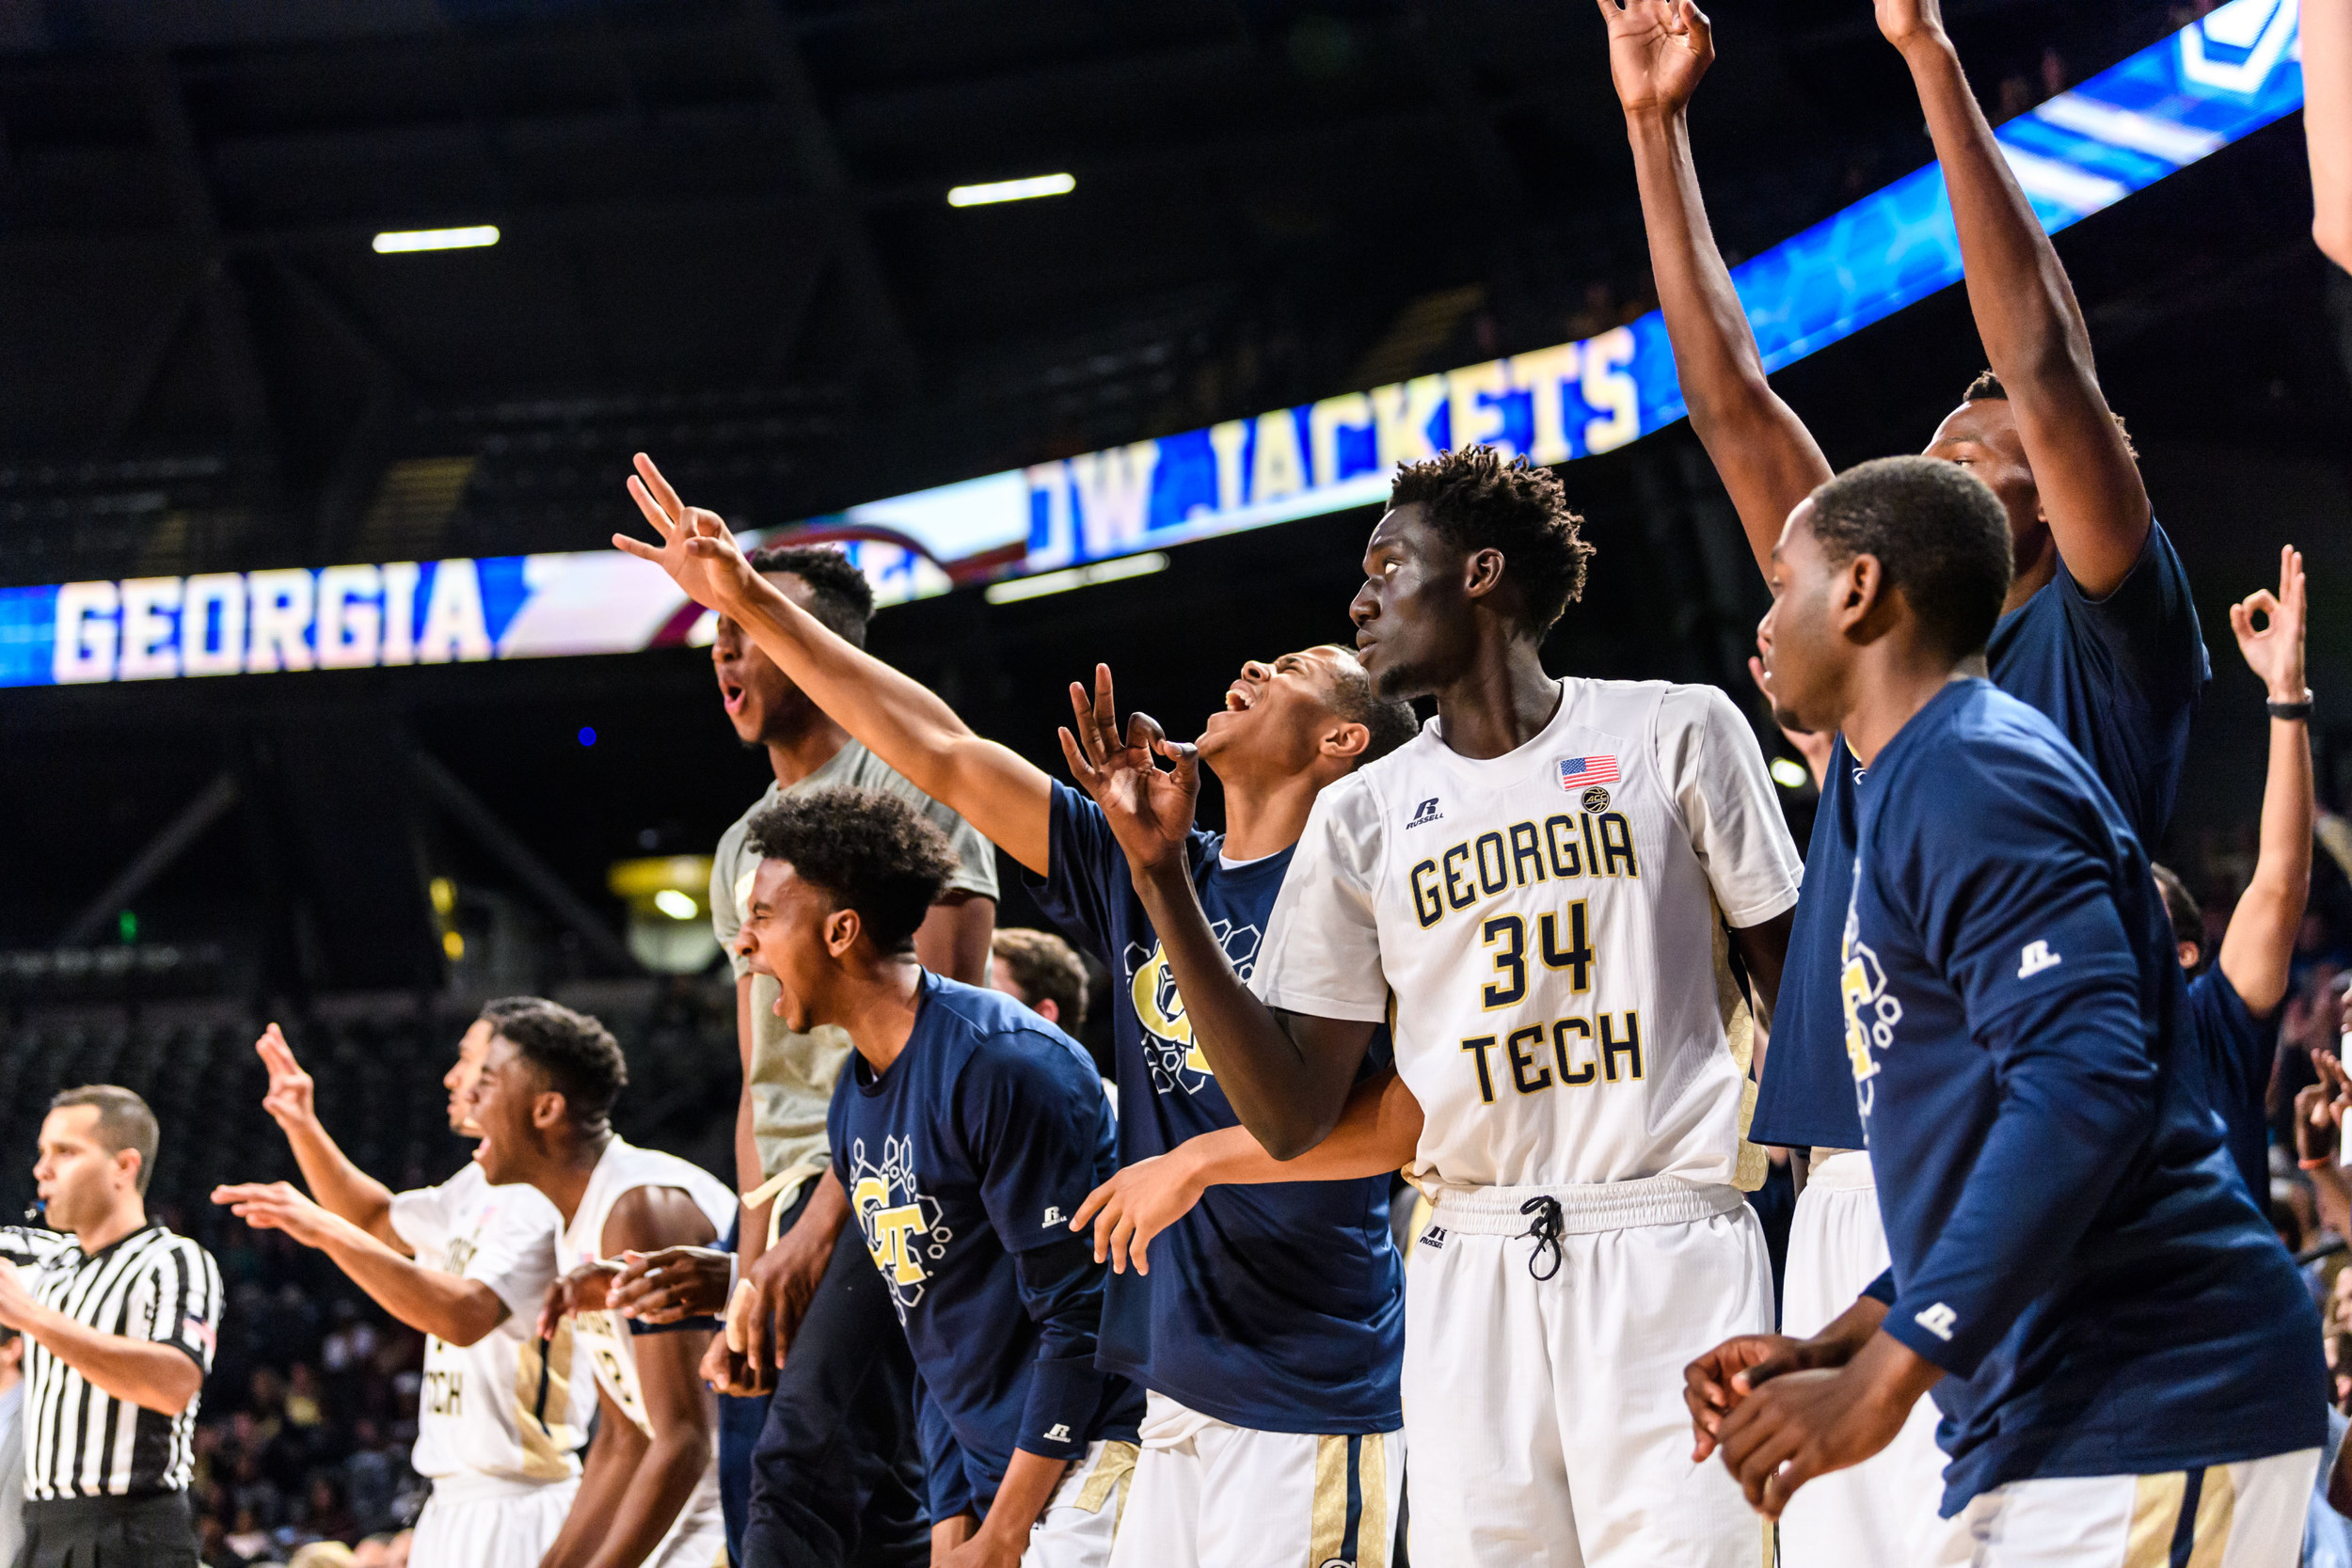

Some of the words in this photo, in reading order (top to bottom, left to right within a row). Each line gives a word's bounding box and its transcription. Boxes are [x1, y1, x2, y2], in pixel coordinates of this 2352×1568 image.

[1186, 325, 1640, 518] JACKETS
[54, 559, 492, 684] GEORGIA
[1406, 813, 1444, 830] RUSSELL
[1409, 811, 1639, 930] GEORGIA
[1482, 898, 1596, 1012] 34
[1460, 1010, 1645, 1104] TECH
